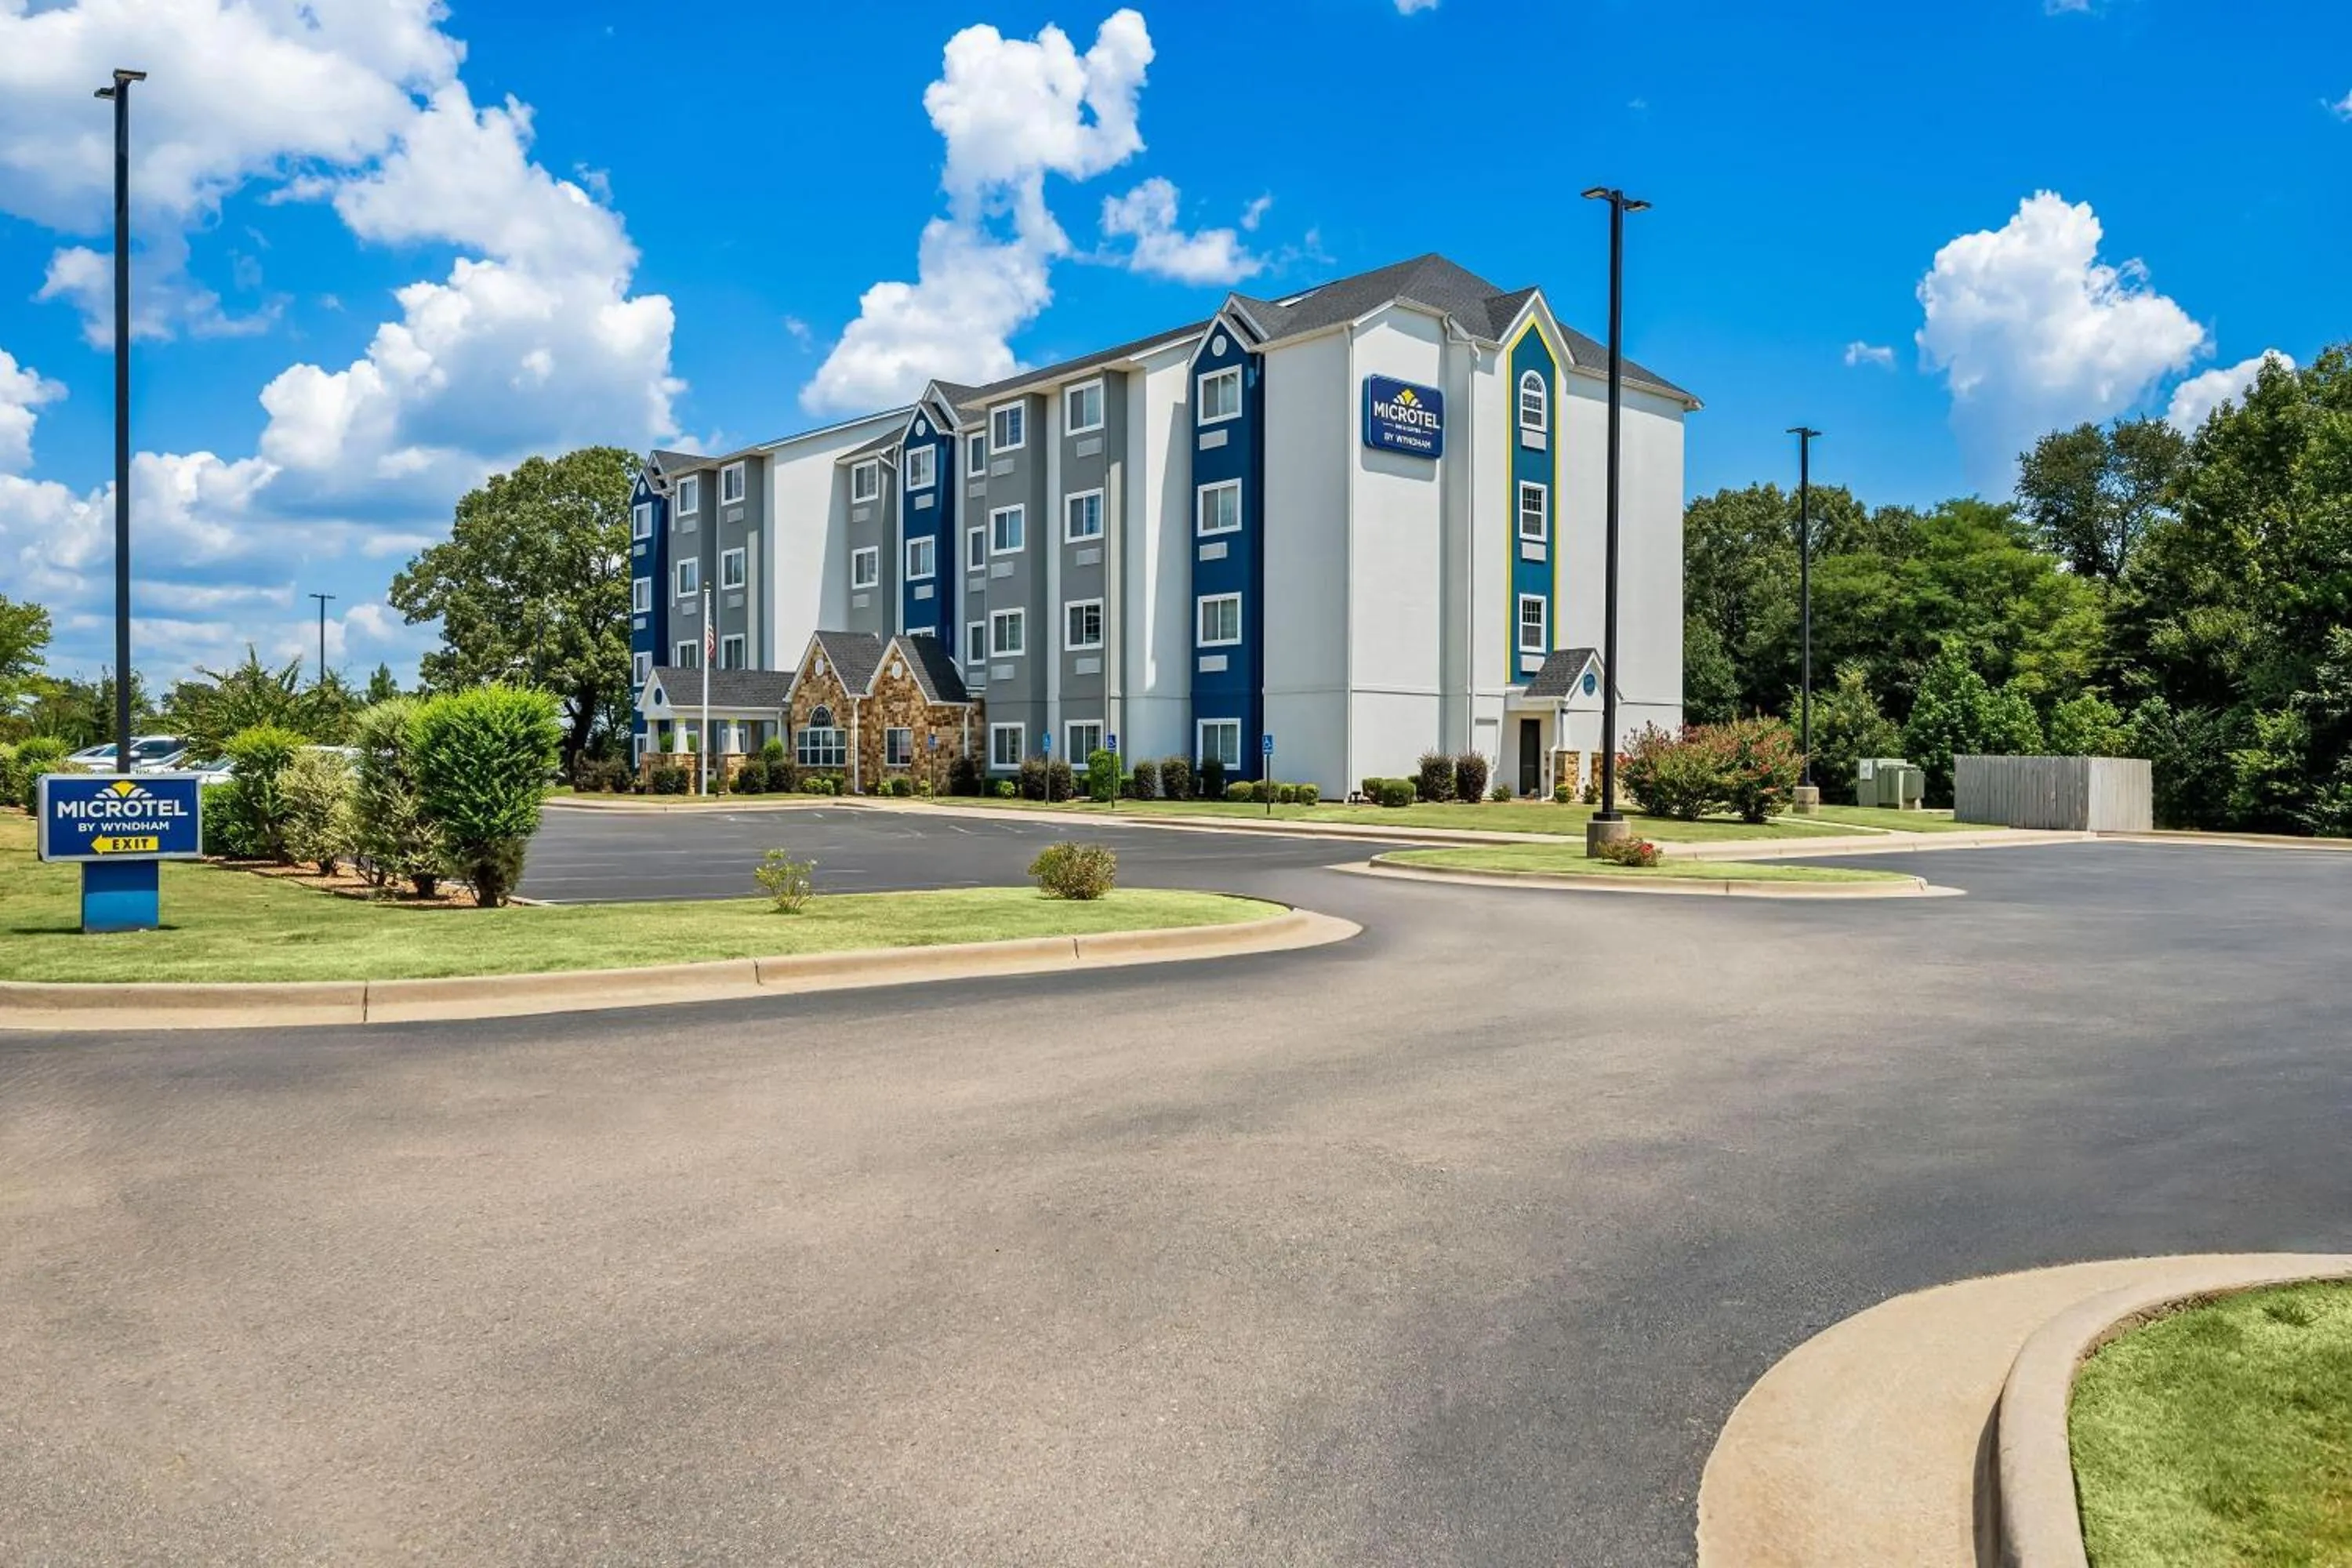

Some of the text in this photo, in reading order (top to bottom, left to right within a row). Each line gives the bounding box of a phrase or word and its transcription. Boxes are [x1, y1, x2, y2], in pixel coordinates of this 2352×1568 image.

[1374, 401, 1440, 429] MICROTEL
[1384, 432, 1394, 441] BY
[57, 800, 188, 818] MICROTEL
[78, 821, 169, 832] BY WYNDHAM
[112, 838, 149, 850] EXIT
